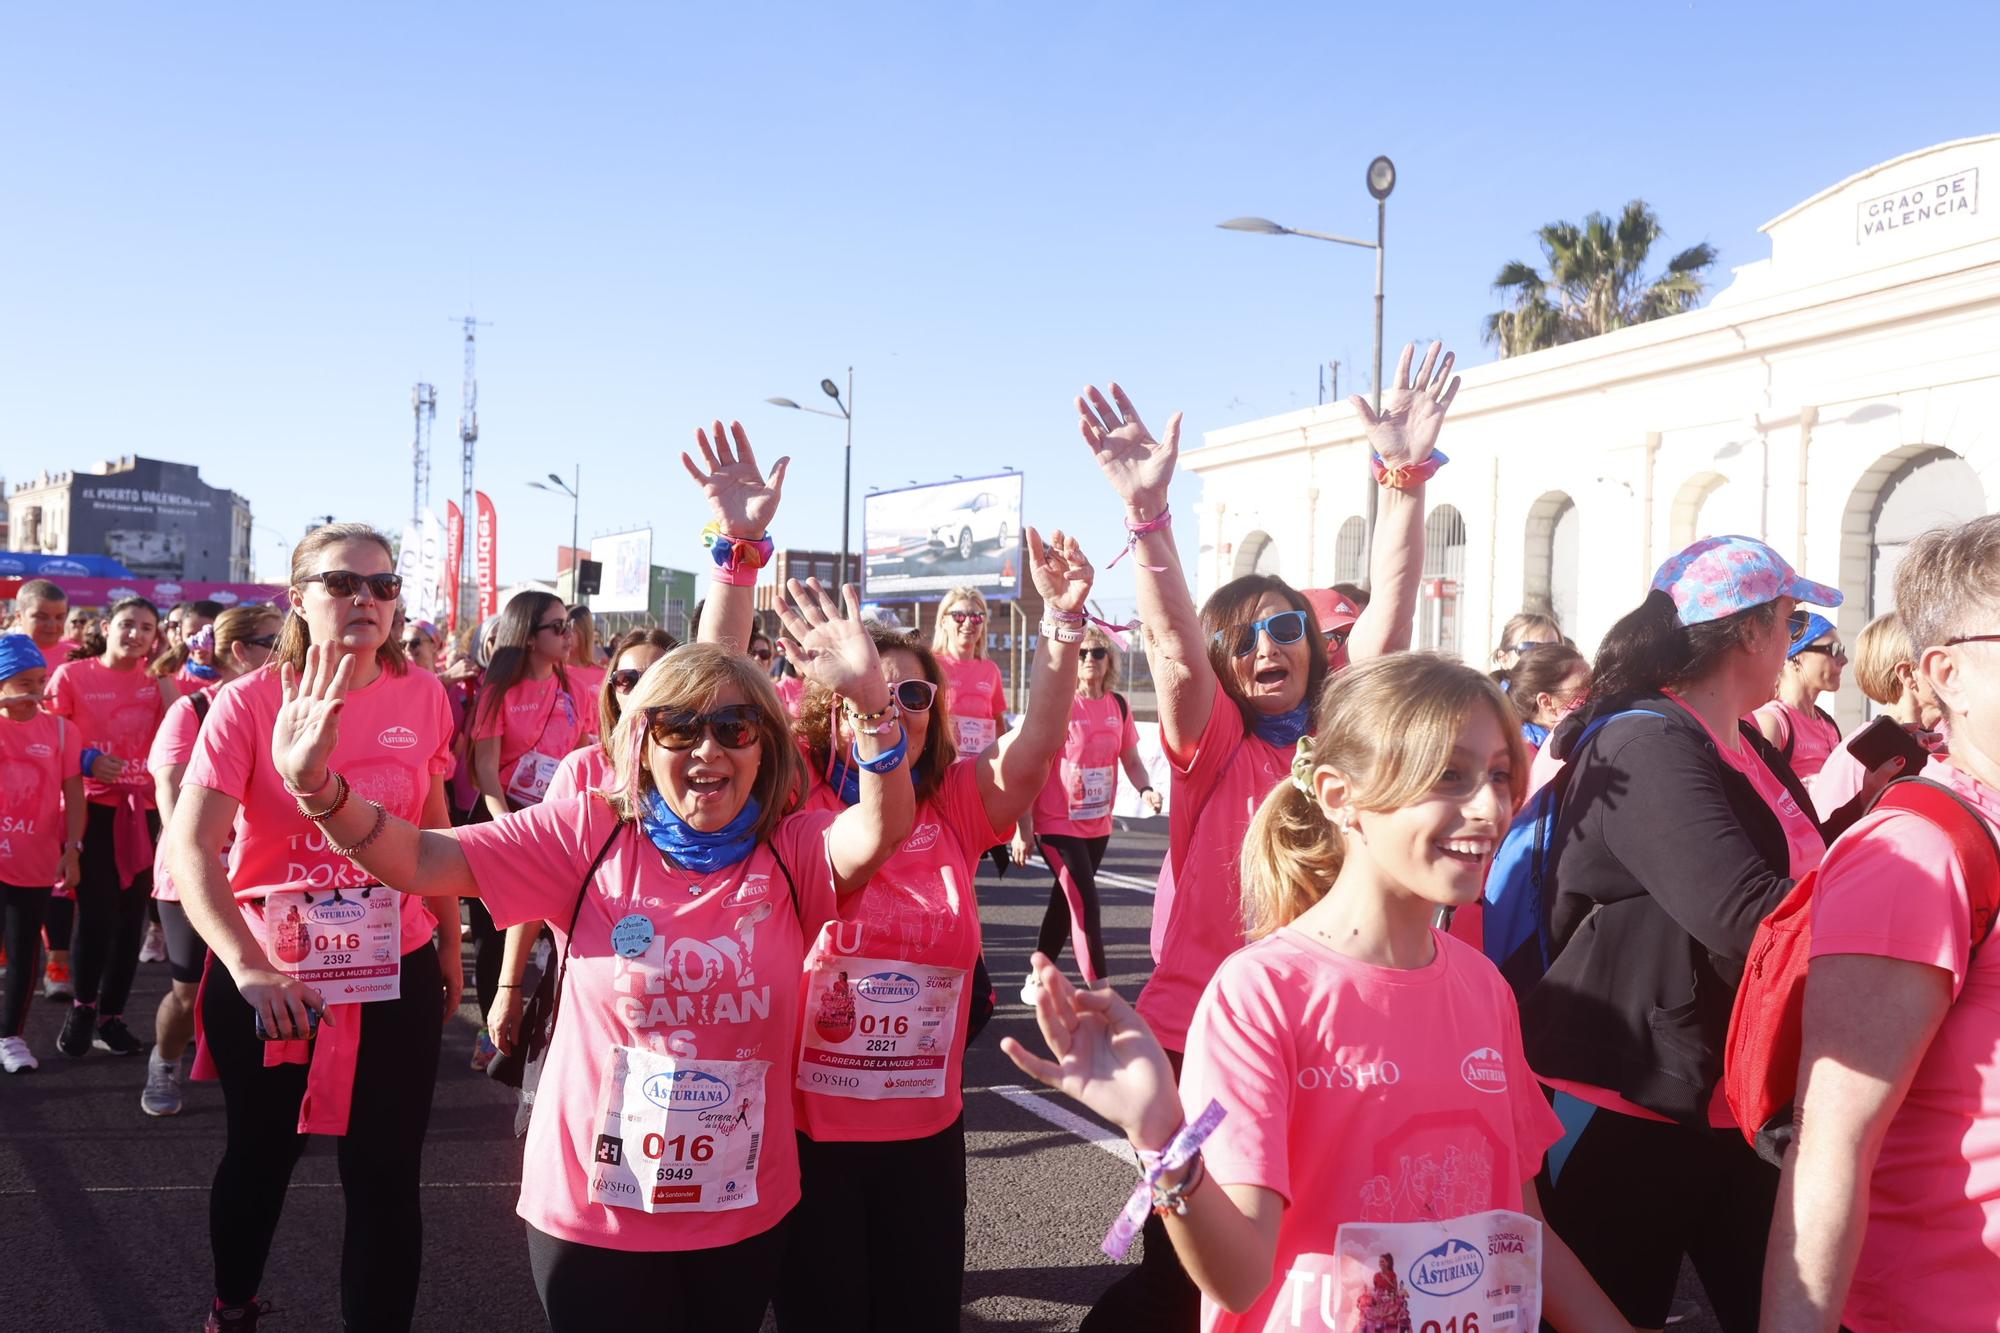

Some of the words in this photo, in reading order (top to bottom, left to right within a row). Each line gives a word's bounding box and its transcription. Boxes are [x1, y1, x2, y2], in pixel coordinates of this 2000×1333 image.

[1869, 192, 1923, 217] GRAO
[1936, 178, 1966, 198] DE
[1864, 197, 1969, 236] VALENCIA
[97, 488, 140, 503] PUERTO
[383, 732, 415, 744] ASTURIANA
[121, 757, 149, 772] RSA
[0, 816, 35, 835] SAL
[286, 832, 327, 851] TU
[283, 863, 376, 888] DORS
[369, 901, 393, 909] SUMA
[311, 909, 362, 920] ASTURIANA
[314, 933, 361, 951] 016
[836, 920, 863, 953] U
[323, 953, 352, 965] 2392
[614, 915, 762, 995] HOY
[355, 983, 393, 993] Santander
[862, 981, 914, 996] ASTURIANA
[925, 981, 952, 989] SUMA
[615, 985, 771, 1029] GANAN
[859, 1014, 909, 1035] 016
[866, 1039, 897, 1052] 2821
[819, 1054, 861, 1067] CARRERA
[916, 1058, 935, 1066] 2023
[812, 1072, 860, 1089] OYSHO
[1297, 1060, 1400, 1089] OYSHO
[895, 1077, 935, 1089] Santander
[648, 1080, 723, 1102] ASTURIANA
[698, 1111, 732, 1122] Carrera
[715, 1121, 737, 1136] Mujer
[642, 1132, 715, 1162] 016
[656, 1167, 693, 1181] 6949
[665, 1191, 694, 1199] Santander
[717, 1193, 744, 1203] ZURICH
[1494, 1233, 1525, 1242] DORSAL
[1488, 1241, 1524, 1256] SUMA
[1416, 1260, 1480, 1286] ASTURIANA
[1420, 1312, 1480, 1333] 016
